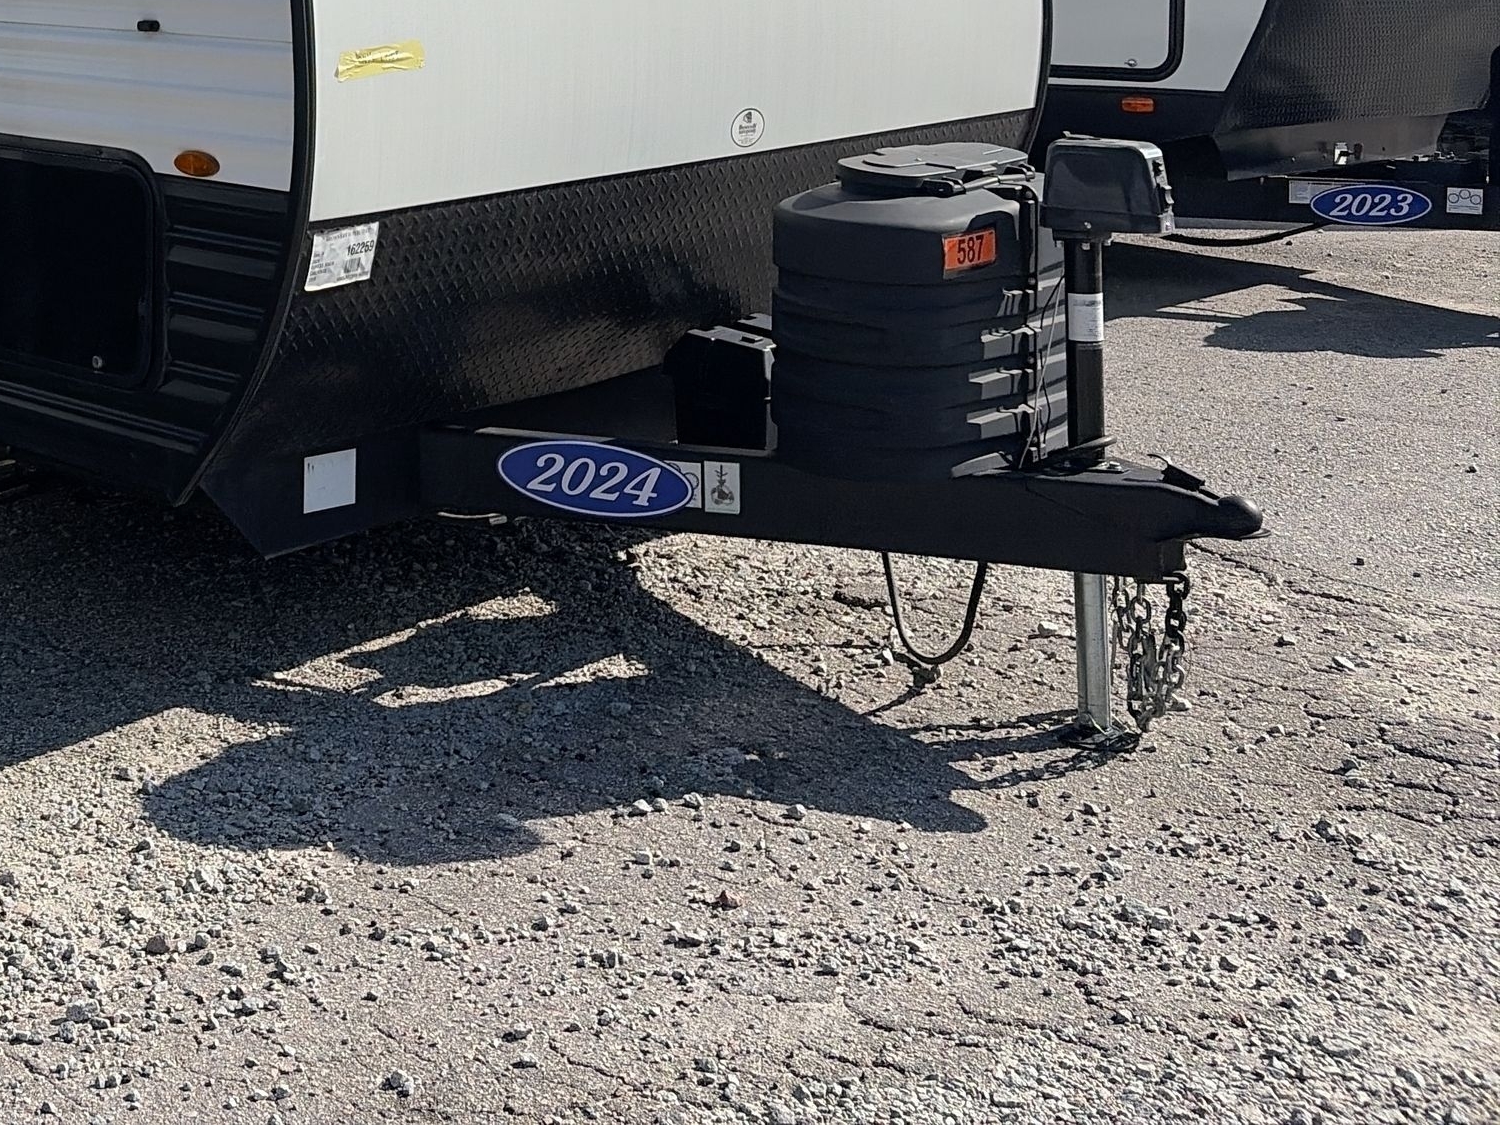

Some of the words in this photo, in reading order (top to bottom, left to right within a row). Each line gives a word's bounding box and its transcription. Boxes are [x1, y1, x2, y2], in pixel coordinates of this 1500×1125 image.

[1328, 192, 1414, 217] 2023
[957, 234, 985, 265] 587
[525, 452, 662, 507] 2024
